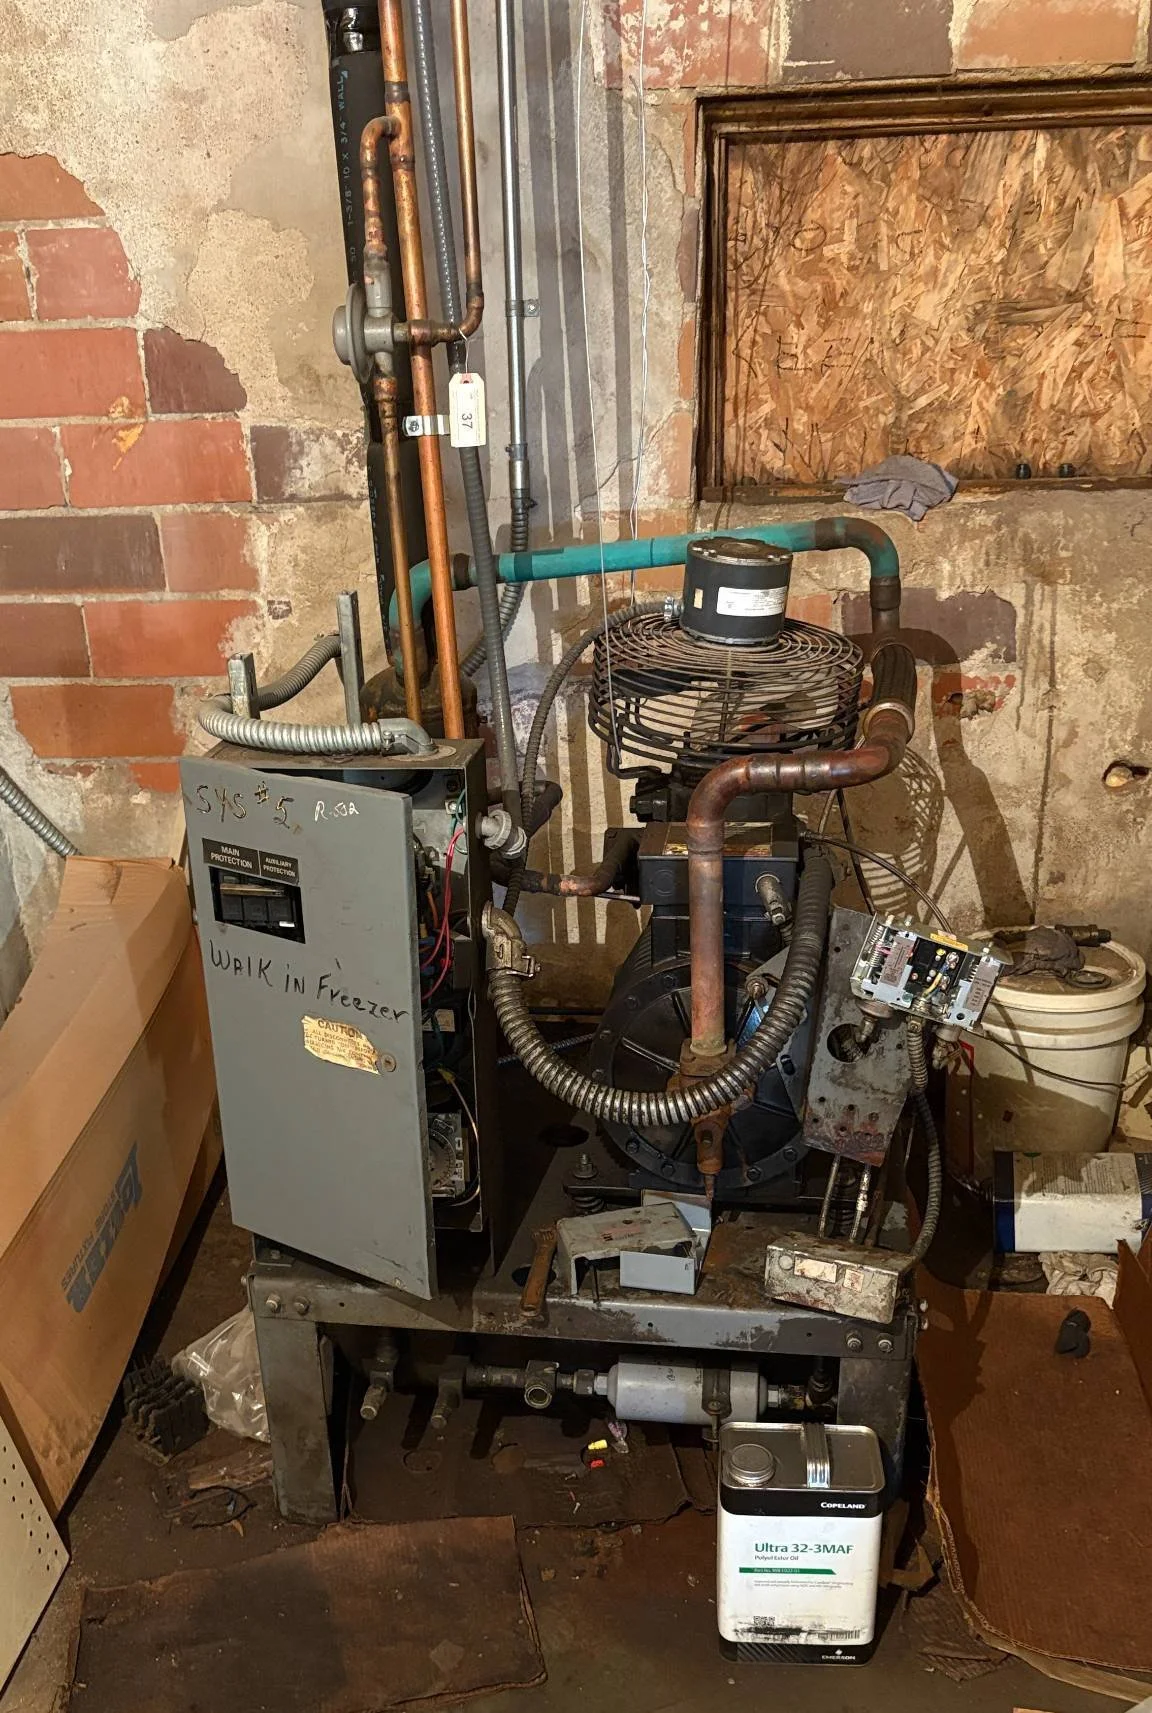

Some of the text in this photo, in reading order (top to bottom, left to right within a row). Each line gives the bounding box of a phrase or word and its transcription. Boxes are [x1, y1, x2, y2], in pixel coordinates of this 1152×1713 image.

[337, 75, 345, 111] WALL
[462, 411, 475, 429] 37
[195, 784, 247, 822] SYS
[221, 845, 240, 856] MAIN
[210, 853, 253, 869] PROTECTION
[265, 857, 292, 868] AUXILIARY
[263, 864, 296, 877] PROTECTION
[316, 972, 410, 1024] Freezer
[317, 1020, 363, 1038] CAUTION
[820, 1502, 866, 1510] COPELAND
[755, 1542, 854, 1555] Ultra 32-3MAF
